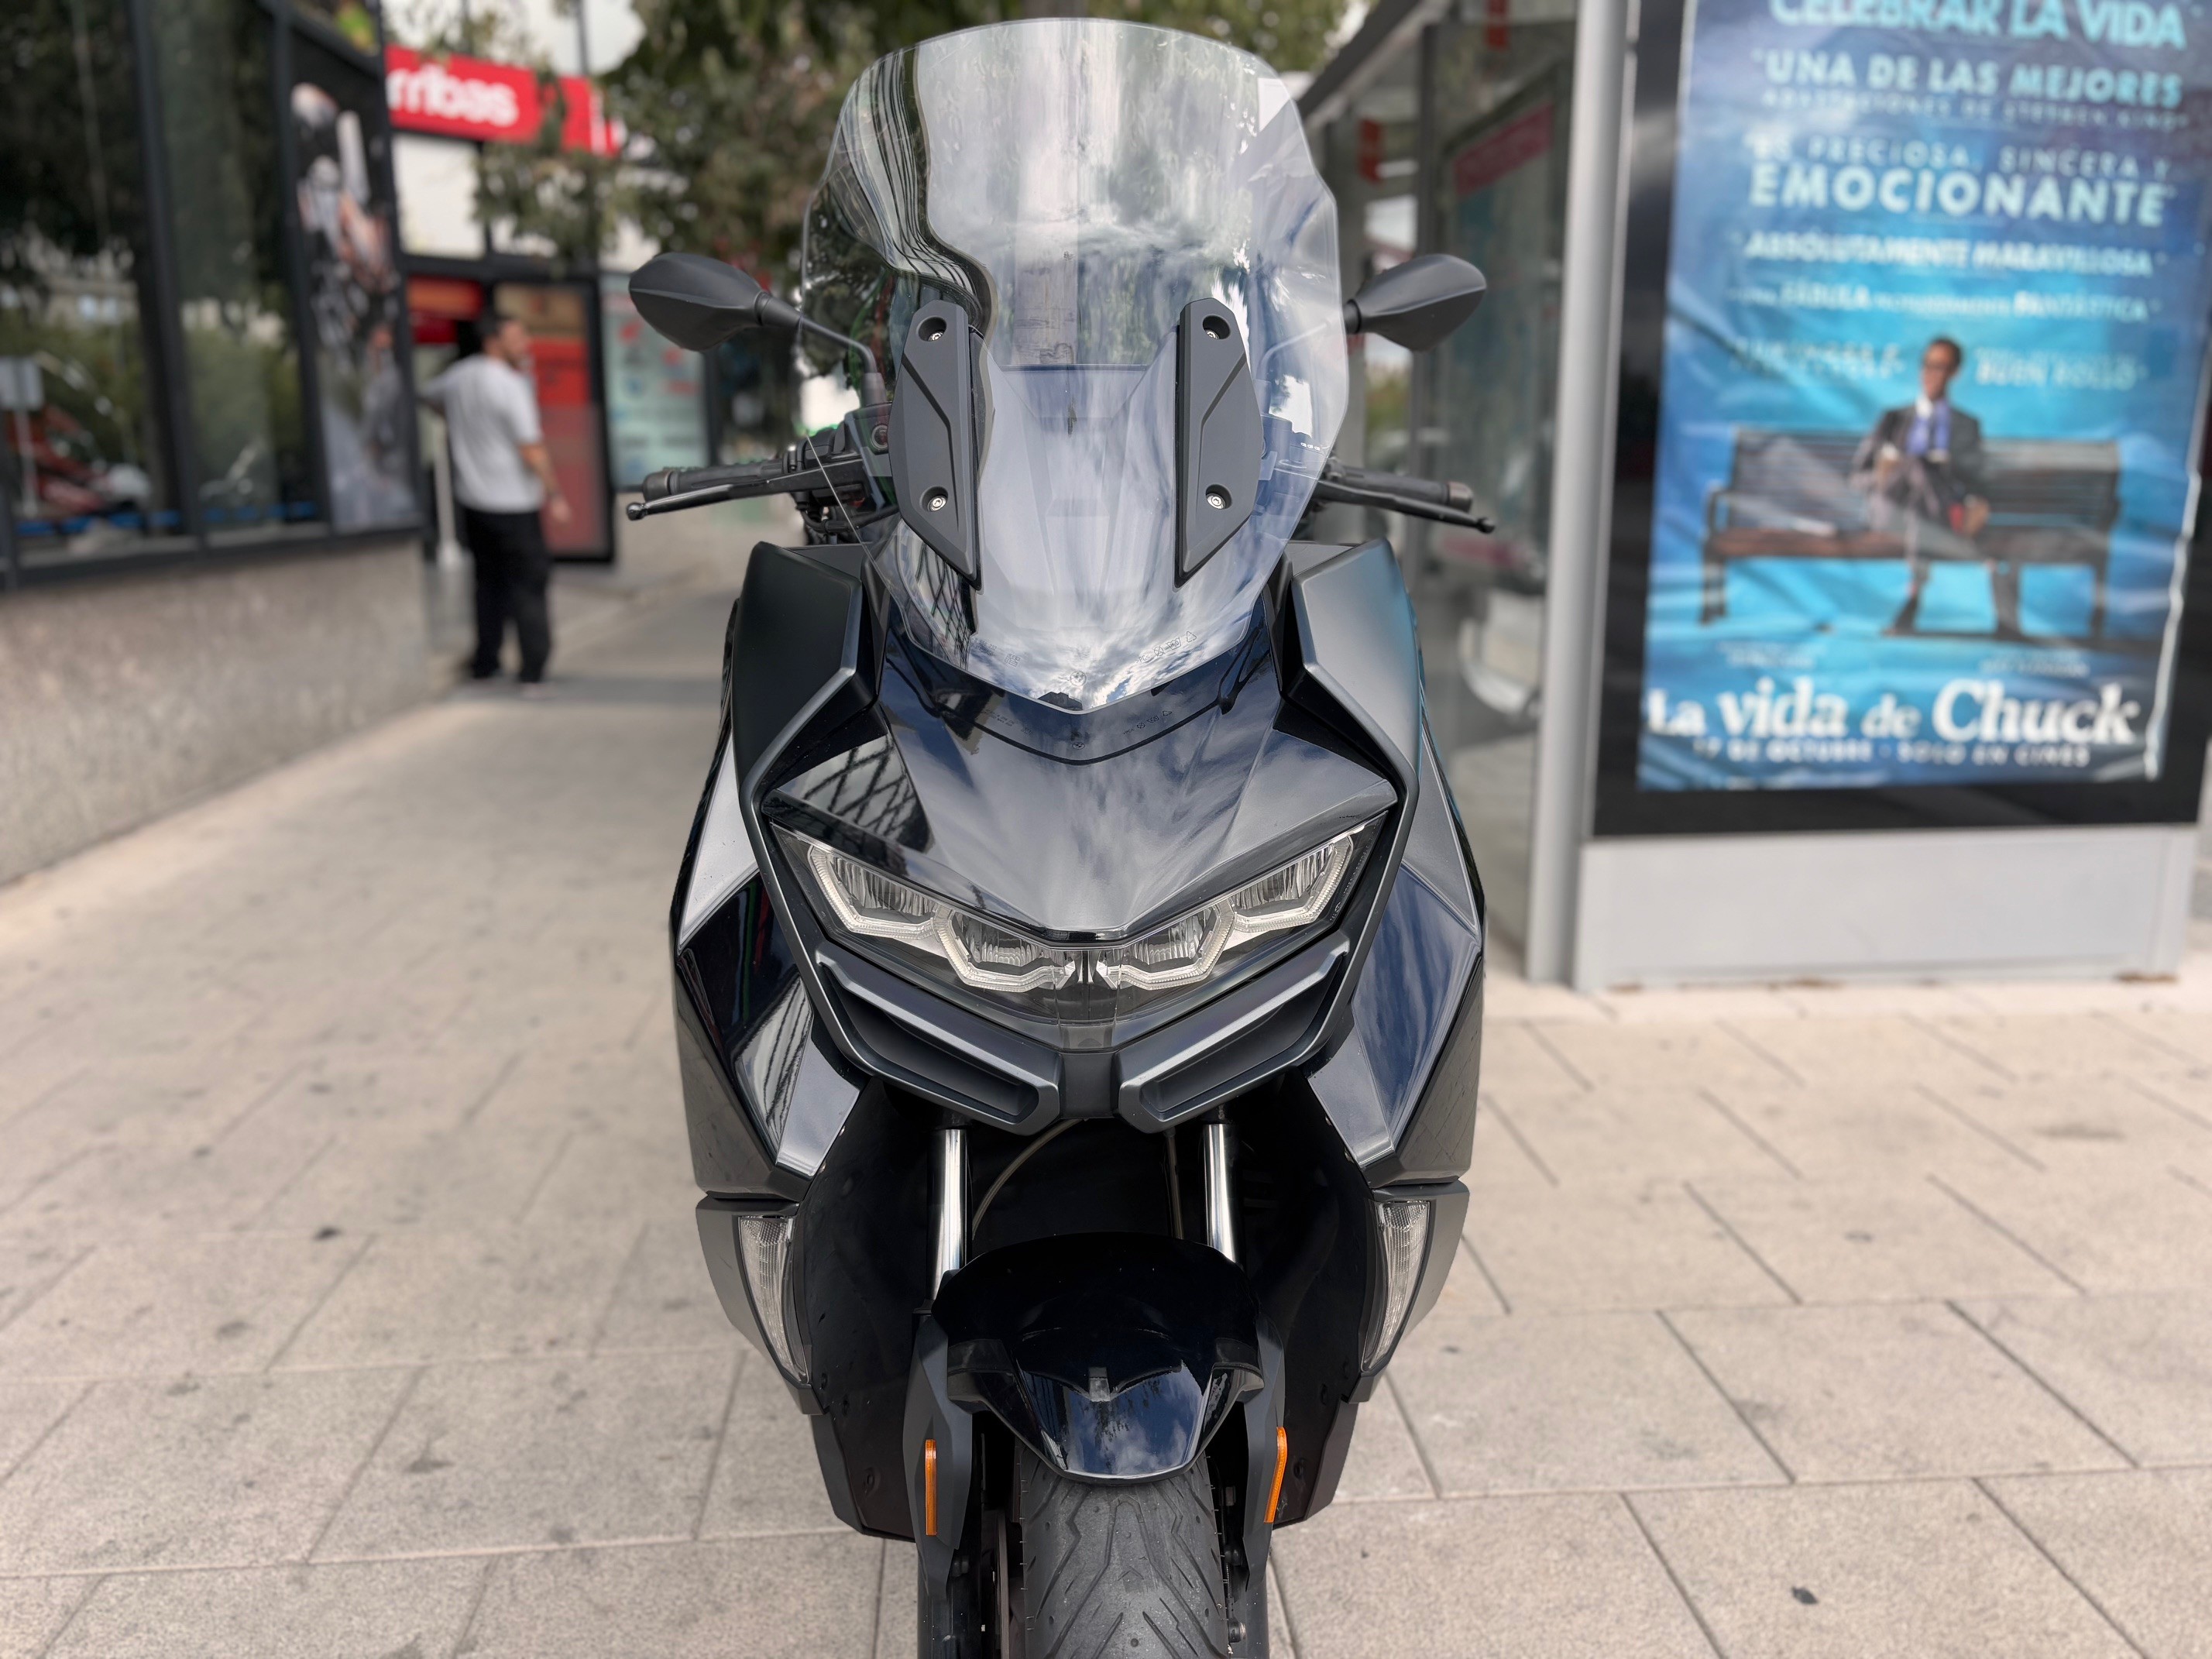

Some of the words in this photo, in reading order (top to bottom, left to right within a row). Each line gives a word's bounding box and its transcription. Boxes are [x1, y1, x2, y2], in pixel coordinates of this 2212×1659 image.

[1769, 0, 1999, 35] CELEBRAR
[2008, 0, 2069, 40] LA
[1867, 52, 1918, 91] DE
[1928, 57, 1999, 95] LAS
[2008, 61, 2183, 108] MEJORES
[1998, 144, 2140, 180] SINCERA
[2150, 156, 2171, 183] Y
[1649, 689, 1706, 737] La
[1717, 675, 1850, 737] vida
[1860, 692, 1922, 739] de
[1932, 678, 2141, 744] Chuck
